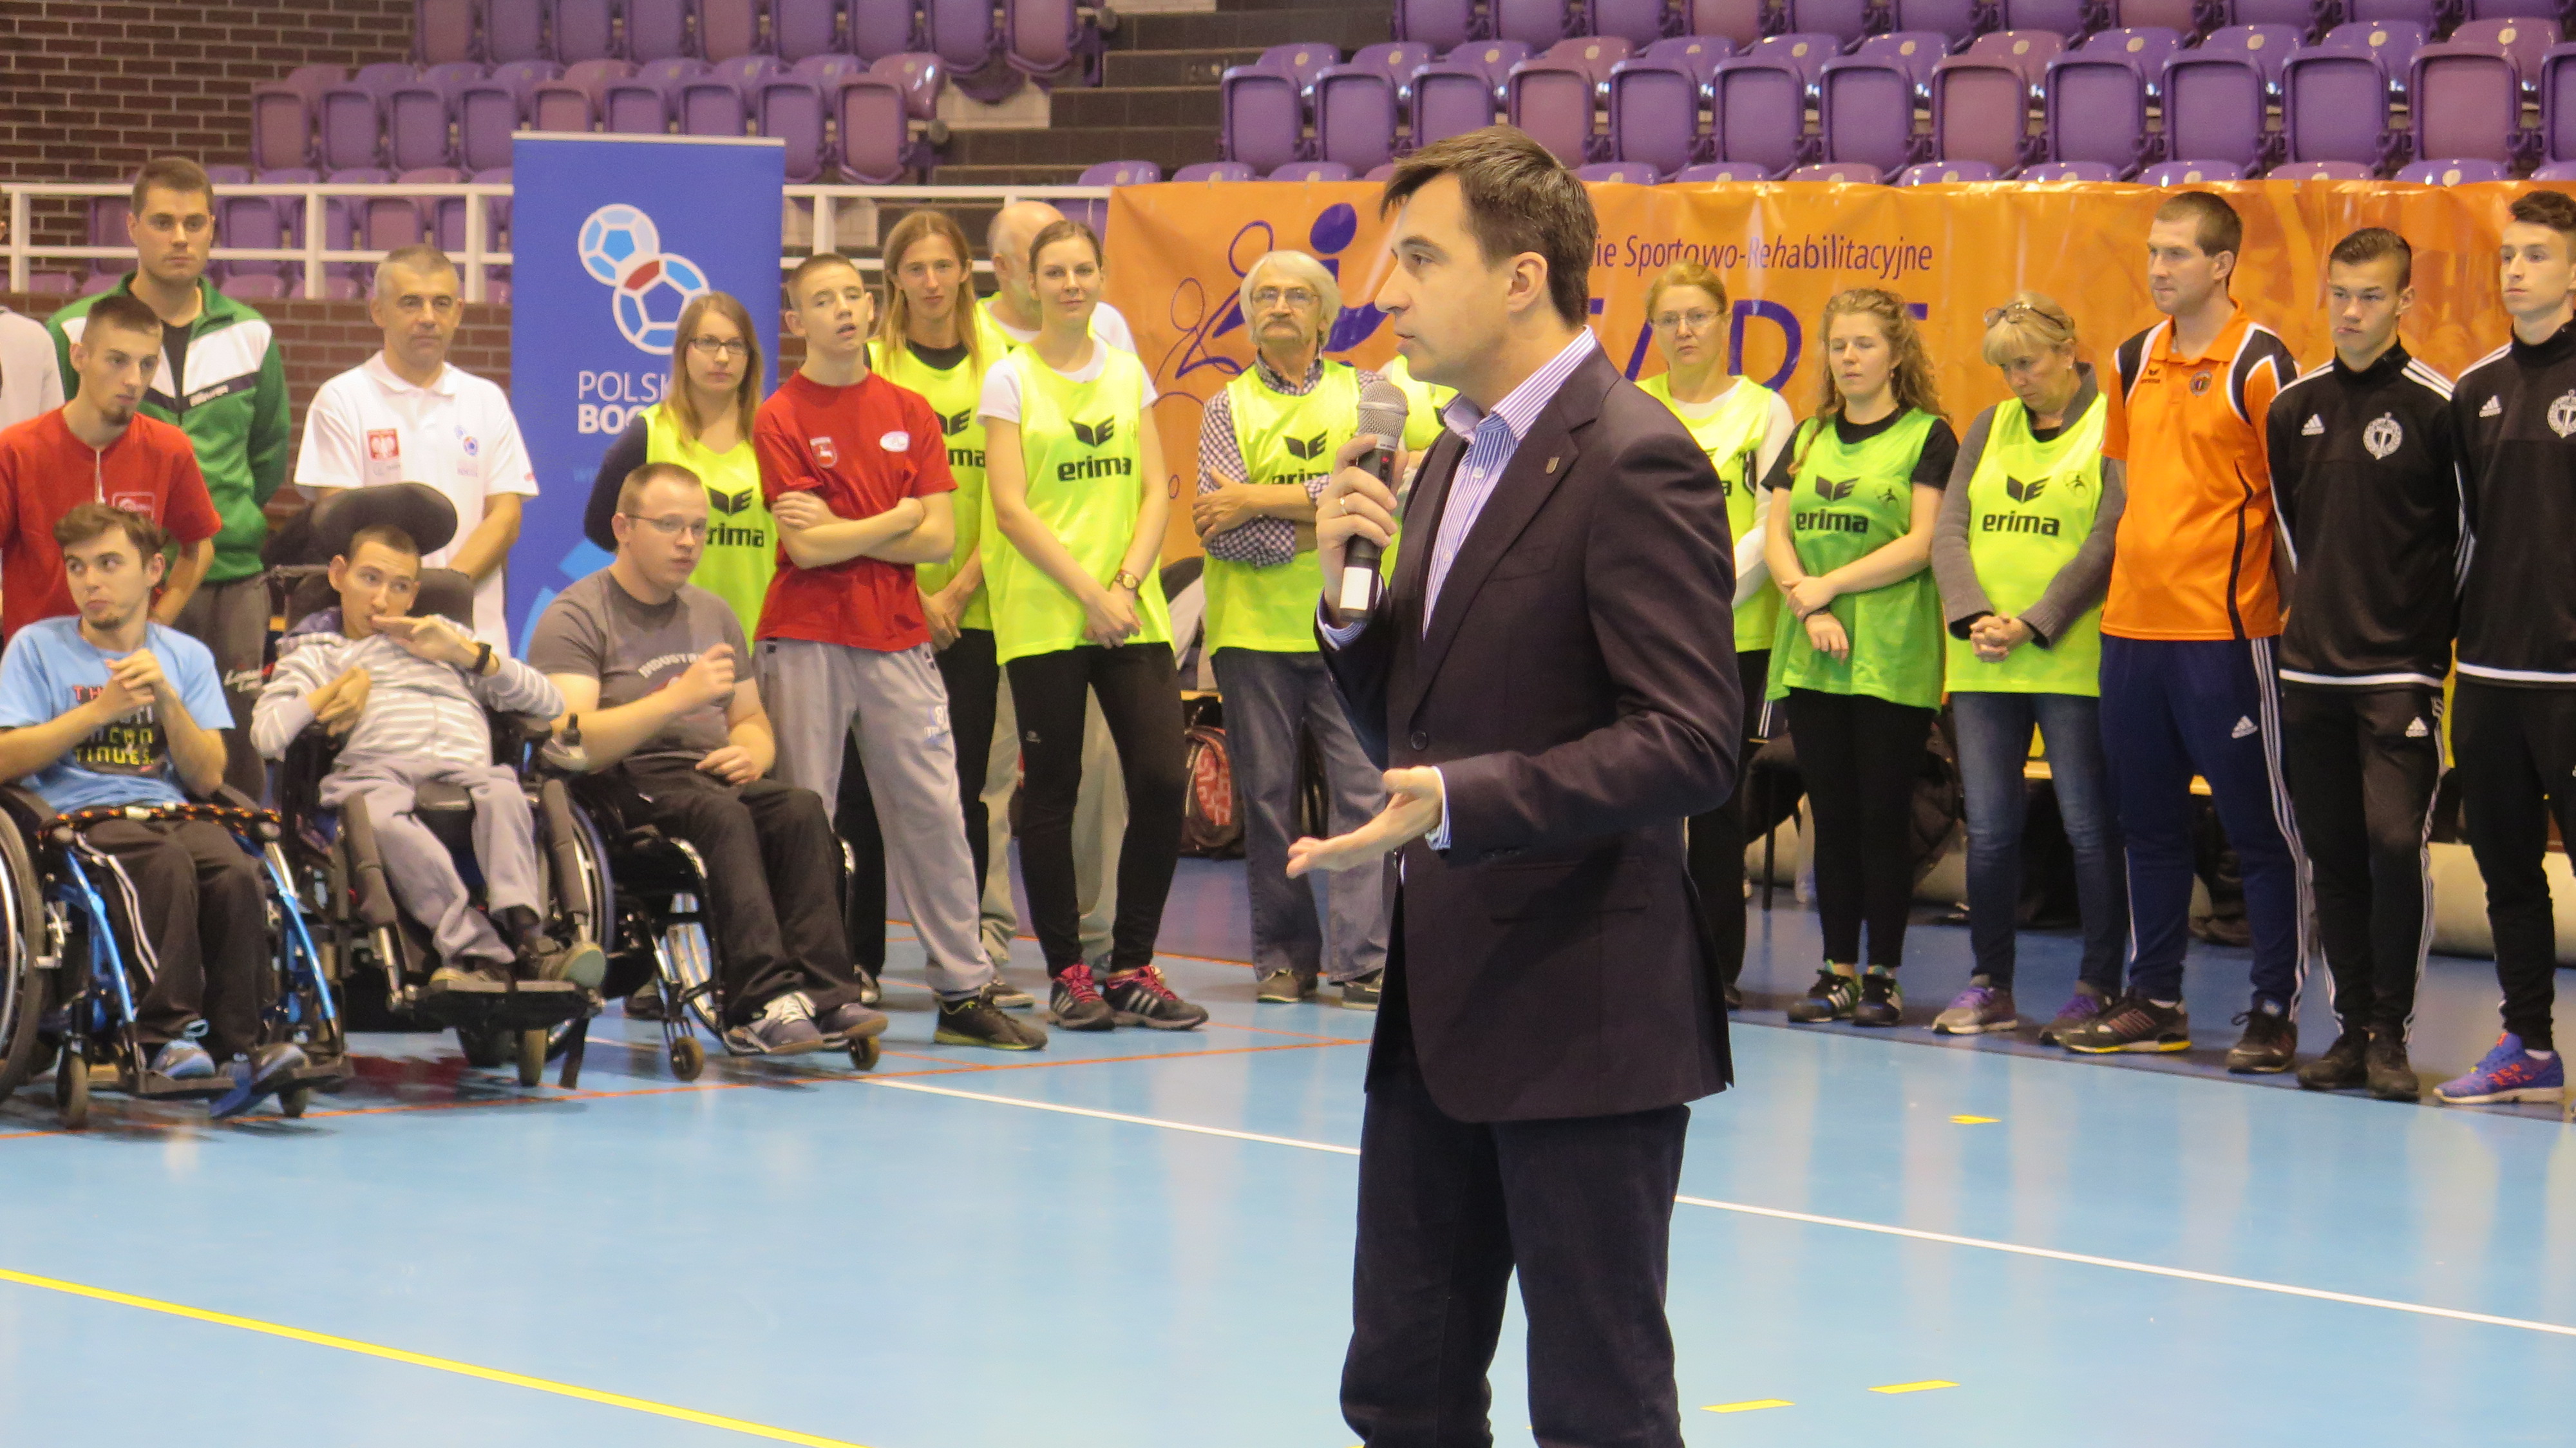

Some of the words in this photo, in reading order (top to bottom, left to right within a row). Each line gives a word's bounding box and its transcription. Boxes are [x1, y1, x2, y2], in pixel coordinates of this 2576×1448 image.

[1596, 234, 1617, 267] ie
[1795, 508, 1870, 533] erima
[1983, 510, 2060, 537] erima
[706, 522, 764, 548] rima
[72, 685, 104, 701] TH
